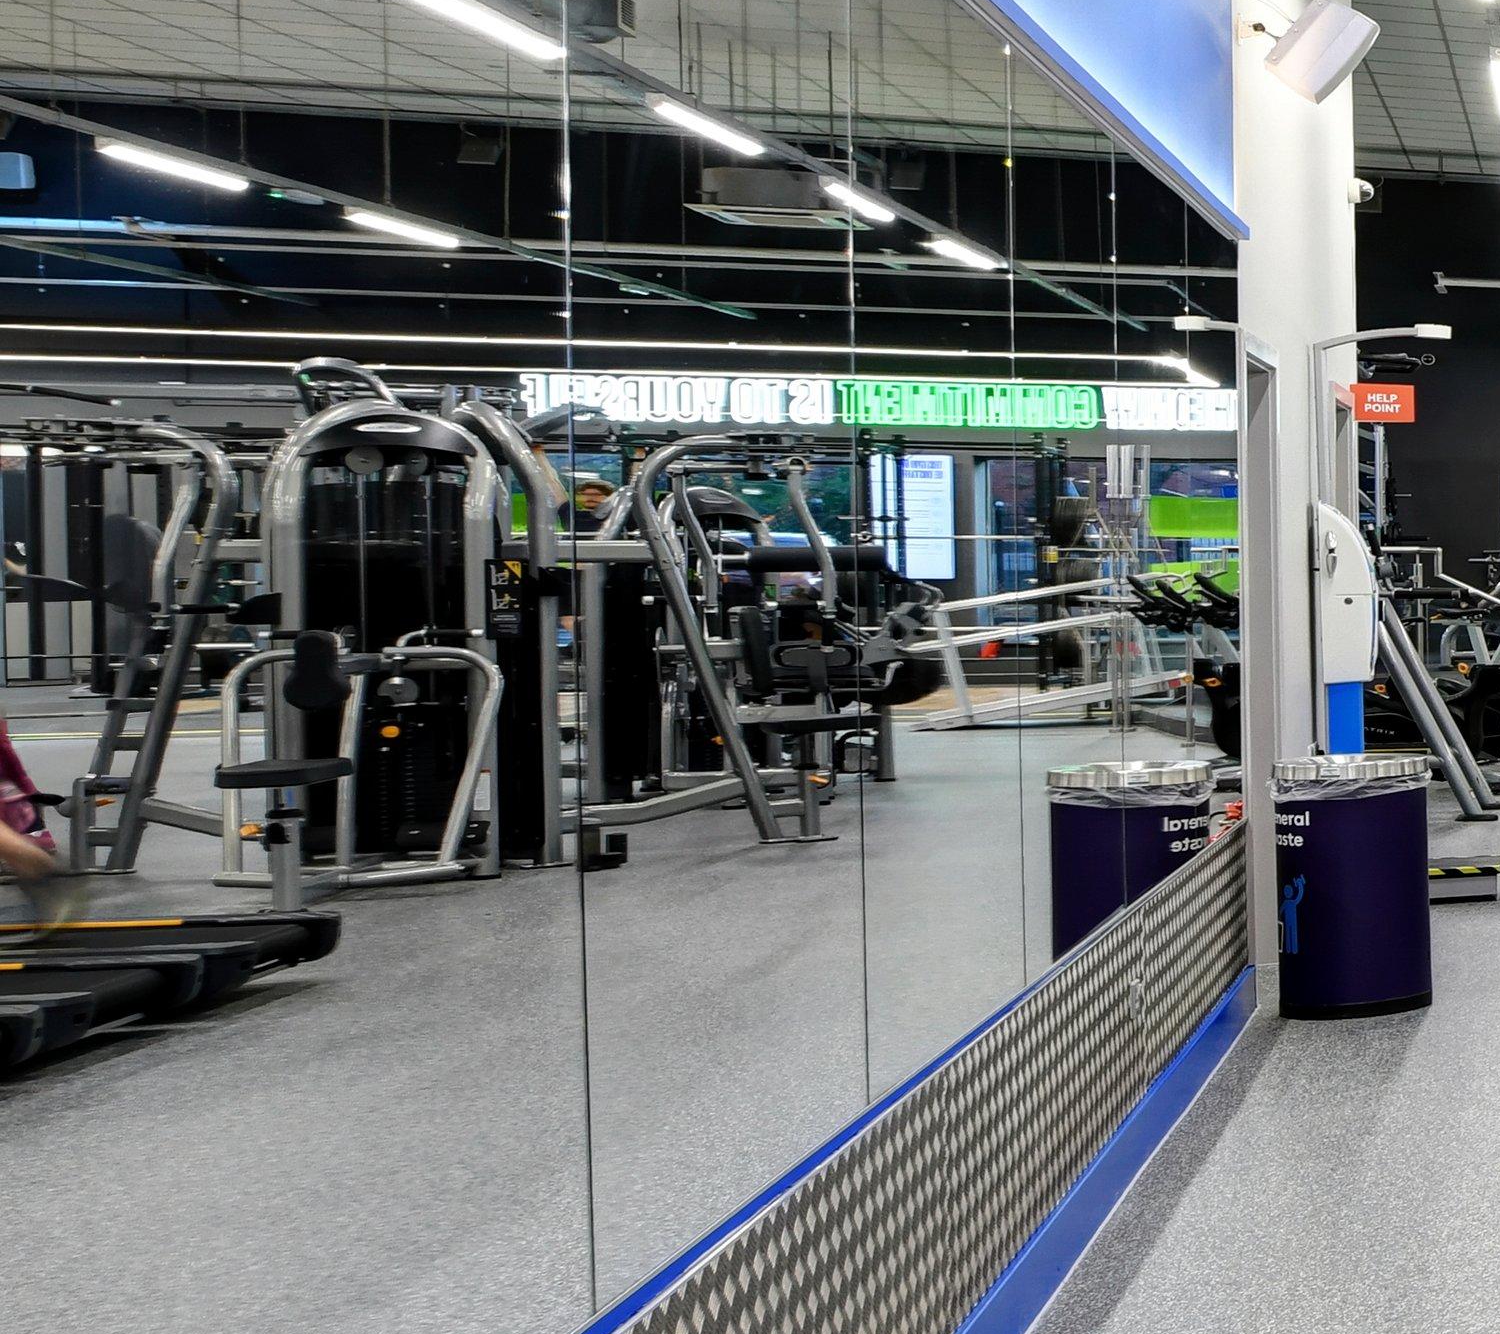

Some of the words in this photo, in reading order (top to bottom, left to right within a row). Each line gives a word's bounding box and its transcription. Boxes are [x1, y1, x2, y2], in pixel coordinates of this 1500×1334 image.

[1367, 393, 1398, 403] HELP
[1364, 403, 1401, 413] POINT
[1365, 727, 1395, 735] TRIX
[1275, 811, 1310, 827] neral
[1277, 833, 1304, 847] aste
